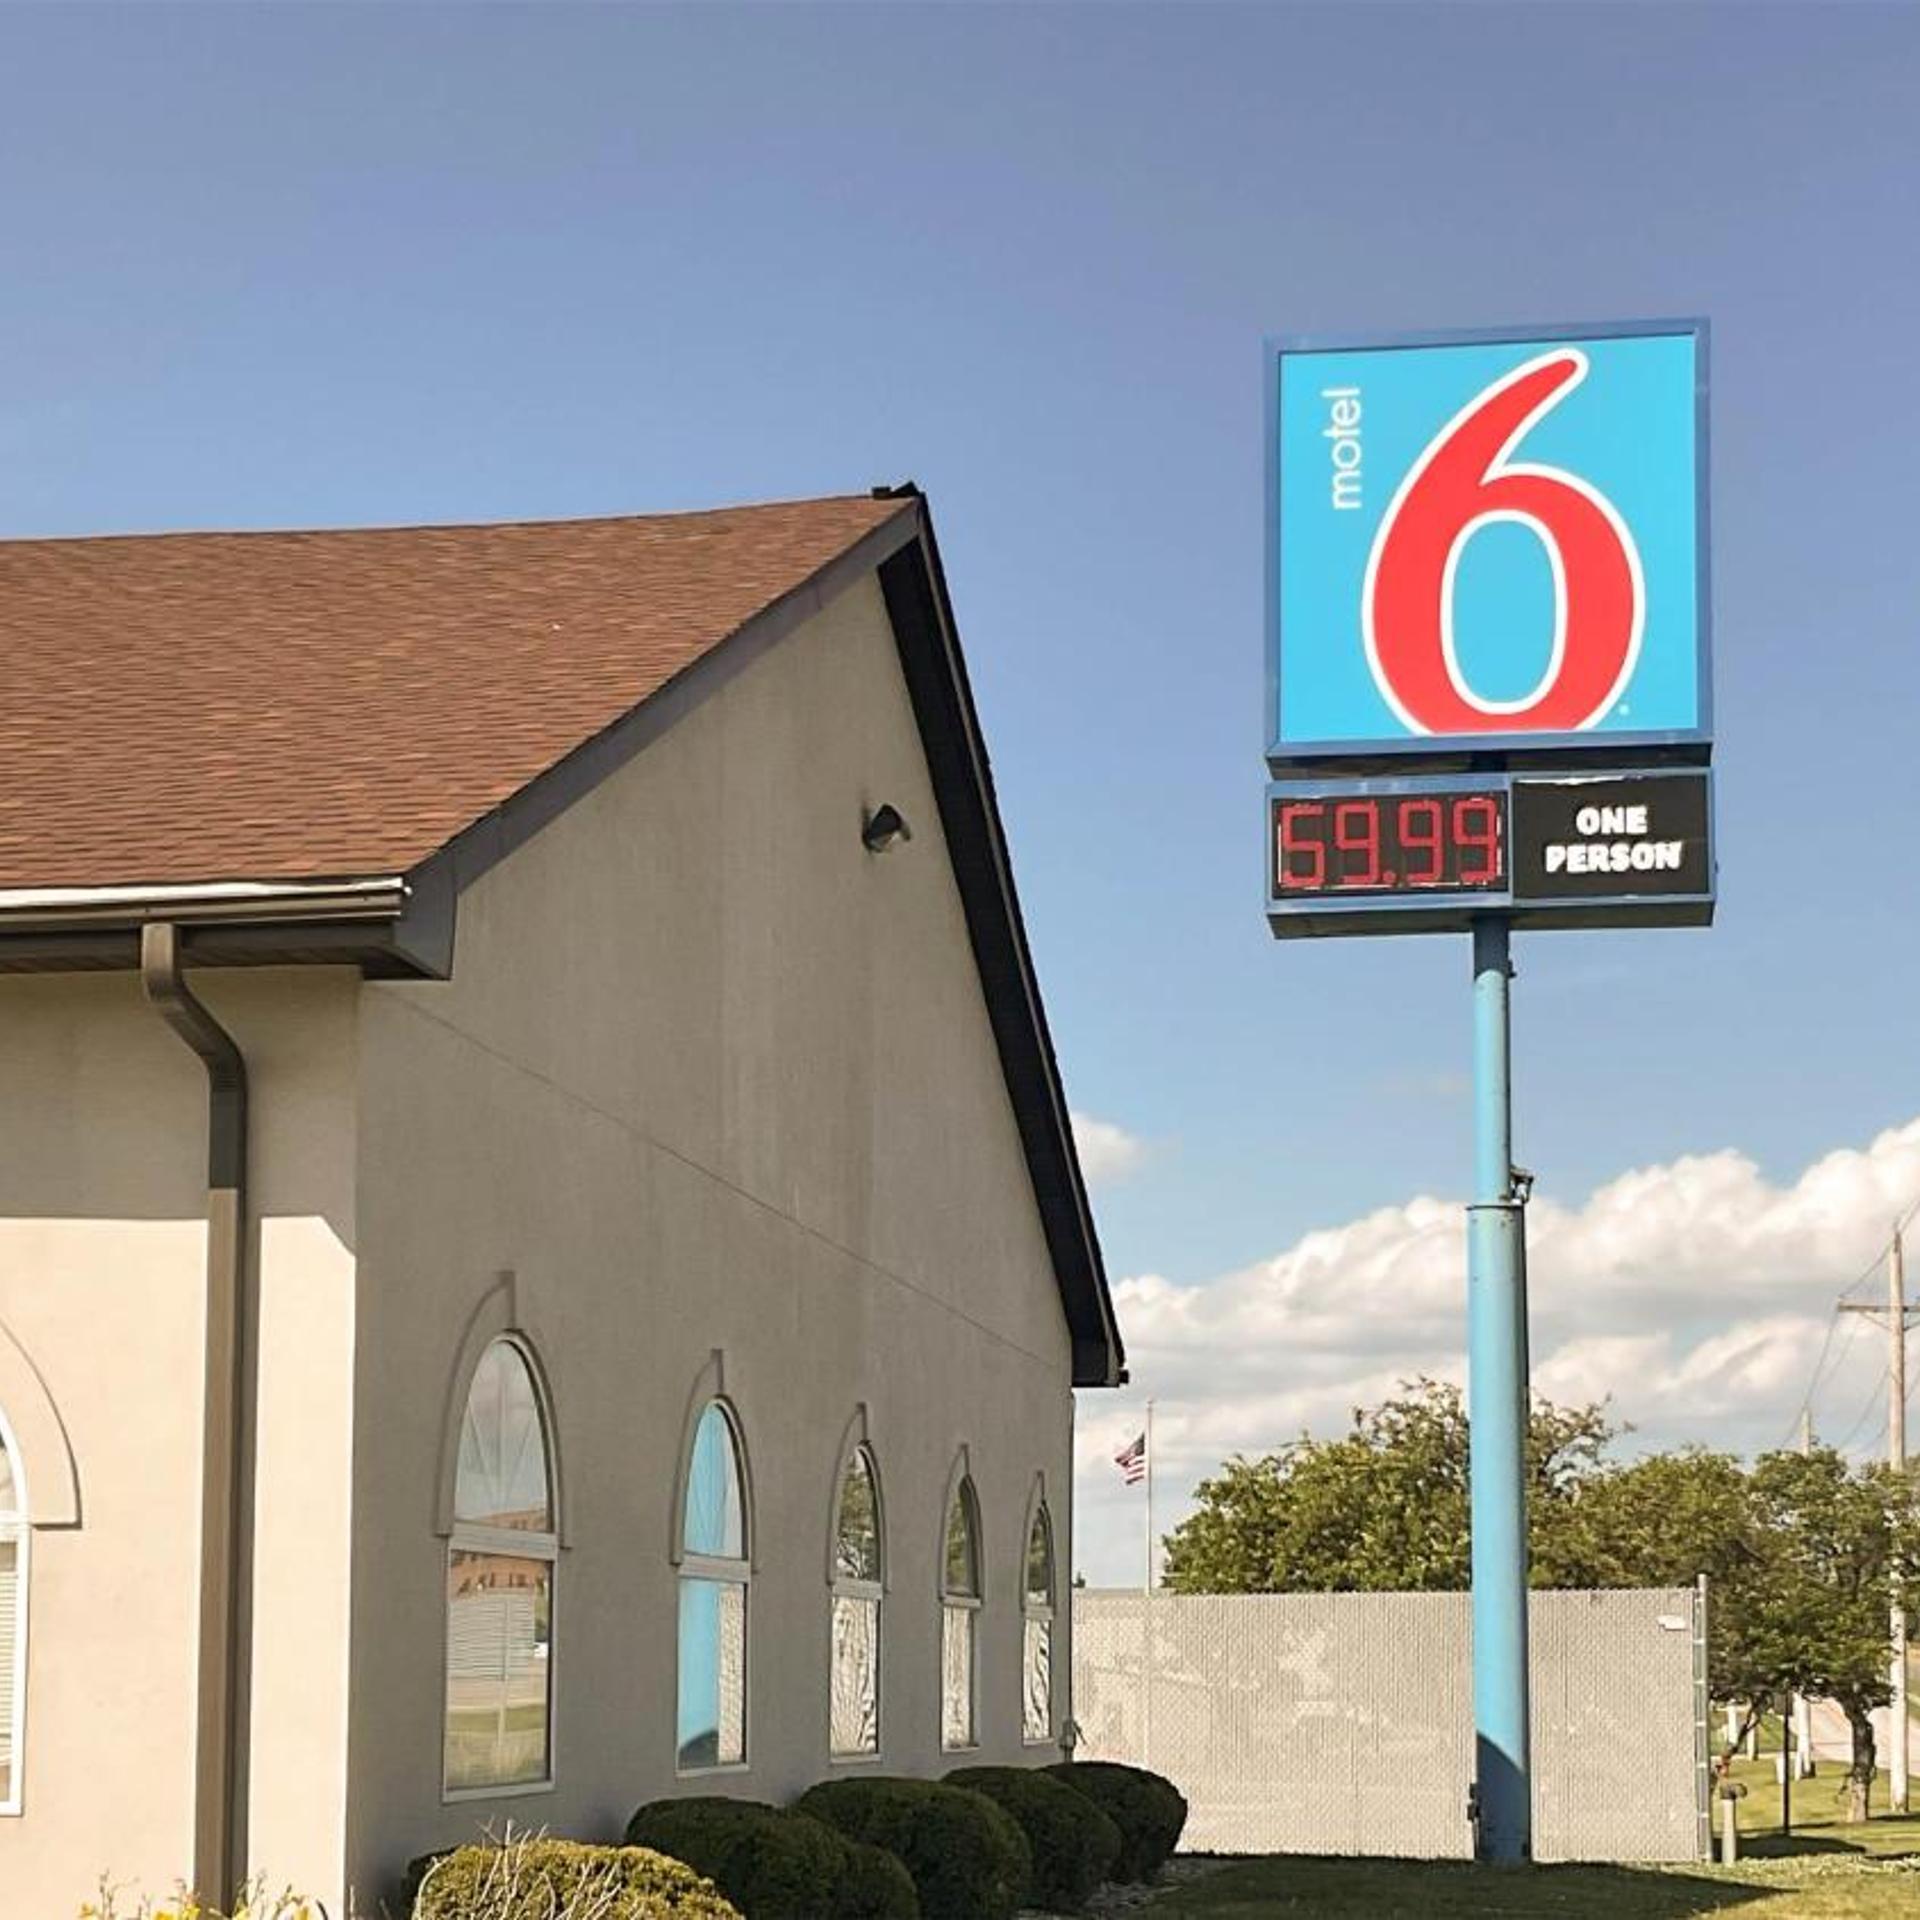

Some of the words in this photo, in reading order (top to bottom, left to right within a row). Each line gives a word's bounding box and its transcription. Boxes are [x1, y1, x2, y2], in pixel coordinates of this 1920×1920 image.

[1322, 387, 1361, 510] motel
[1361, 347, 1646, 736] 6
[1280, 798, 1498, 888] 59.99
[1545, 840, 1684, 873] PERSON
[1576, 805, 1648, 836] ONE
